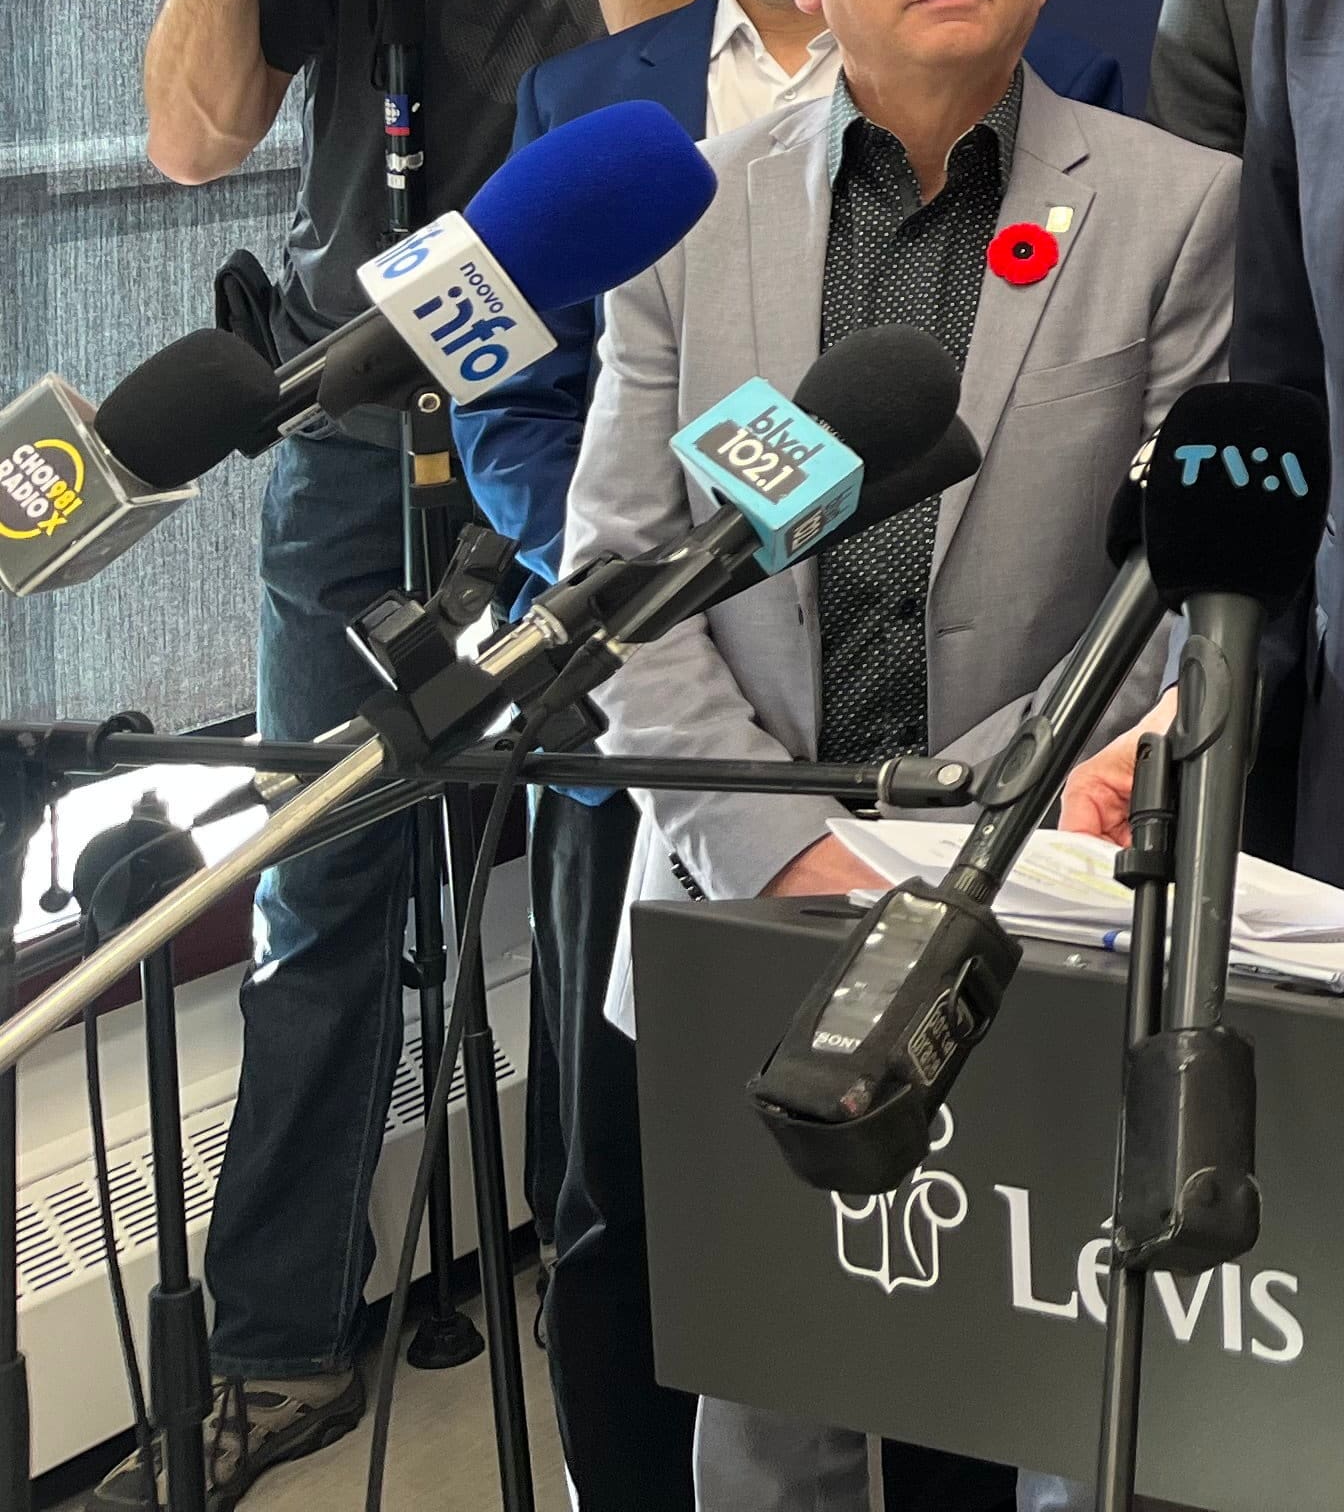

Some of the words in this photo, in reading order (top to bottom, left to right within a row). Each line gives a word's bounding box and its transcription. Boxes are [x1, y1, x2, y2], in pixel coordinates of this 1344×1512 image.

[460, 261, 504, 314] noovo
[412, 286, 518, 382] info
[717, 428, 795, 493] 102.1
[748, 405, 826, 469] blvd
